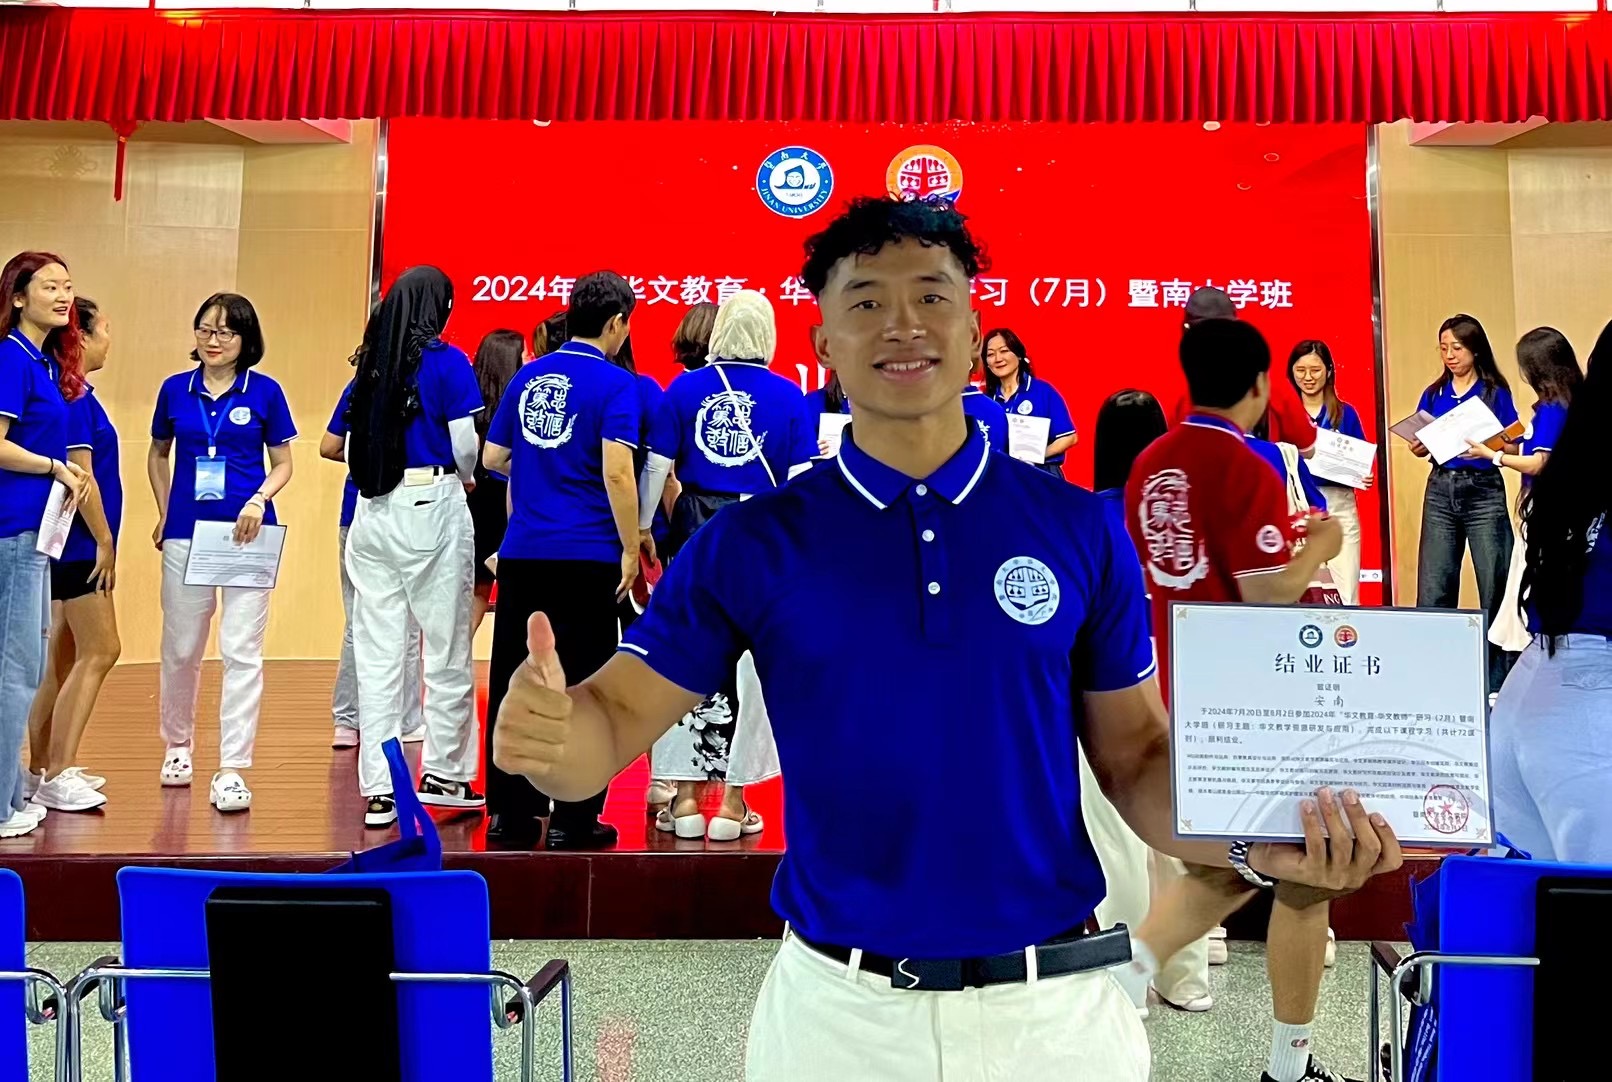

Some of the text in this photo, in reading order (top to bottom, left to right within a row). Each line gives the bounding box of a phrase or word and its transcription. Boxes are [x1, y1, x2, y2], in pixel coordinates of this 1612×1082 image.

[760, 188, 828, 214] JINAN UNIVERSITY
[1275, 653, 1381, 676] 结业证书
